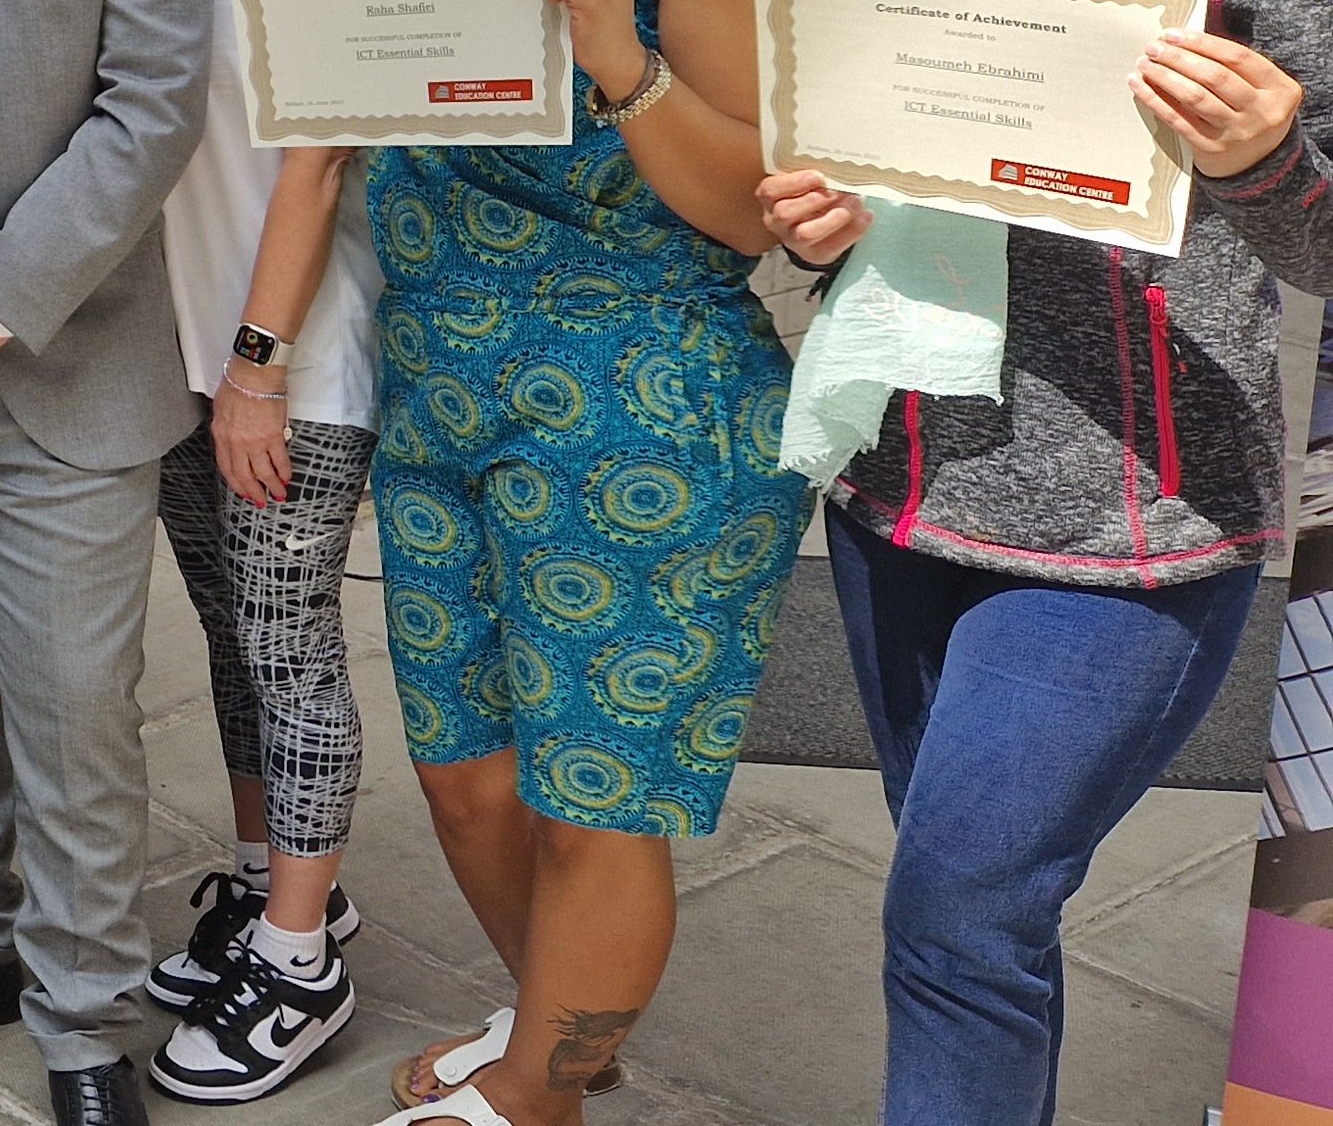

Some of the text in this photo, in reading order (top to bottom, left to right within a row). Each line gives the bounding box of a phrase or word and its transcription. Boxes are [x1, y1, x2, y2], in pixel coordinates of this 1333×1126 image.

[366, 5, 394, 16] Raha
[875, 3, 1067, 34] Certificate of Achievement
[361, 34, 405, 42] SUCCESSFUL
[944, 29, 996, 42] Awarded to
[357, 46, 455, 60] ICT Essential Skills
[895, 52, 1045, 83] Masoumeh Ebrahimi
[454, 82, 486, 91] CONWAY
[454, 91, 521, 100] EDUCATION CENTRE
[893, 84, 1046, 112] FOR SUCCESSFUL COMPLETION OF
[904, 100, 1032, 129] ICT Essential Skills
[1025, 166, 1069, 181] CONWAY
[1024, 177, 1114, 200] EDUCATION CENTRE
